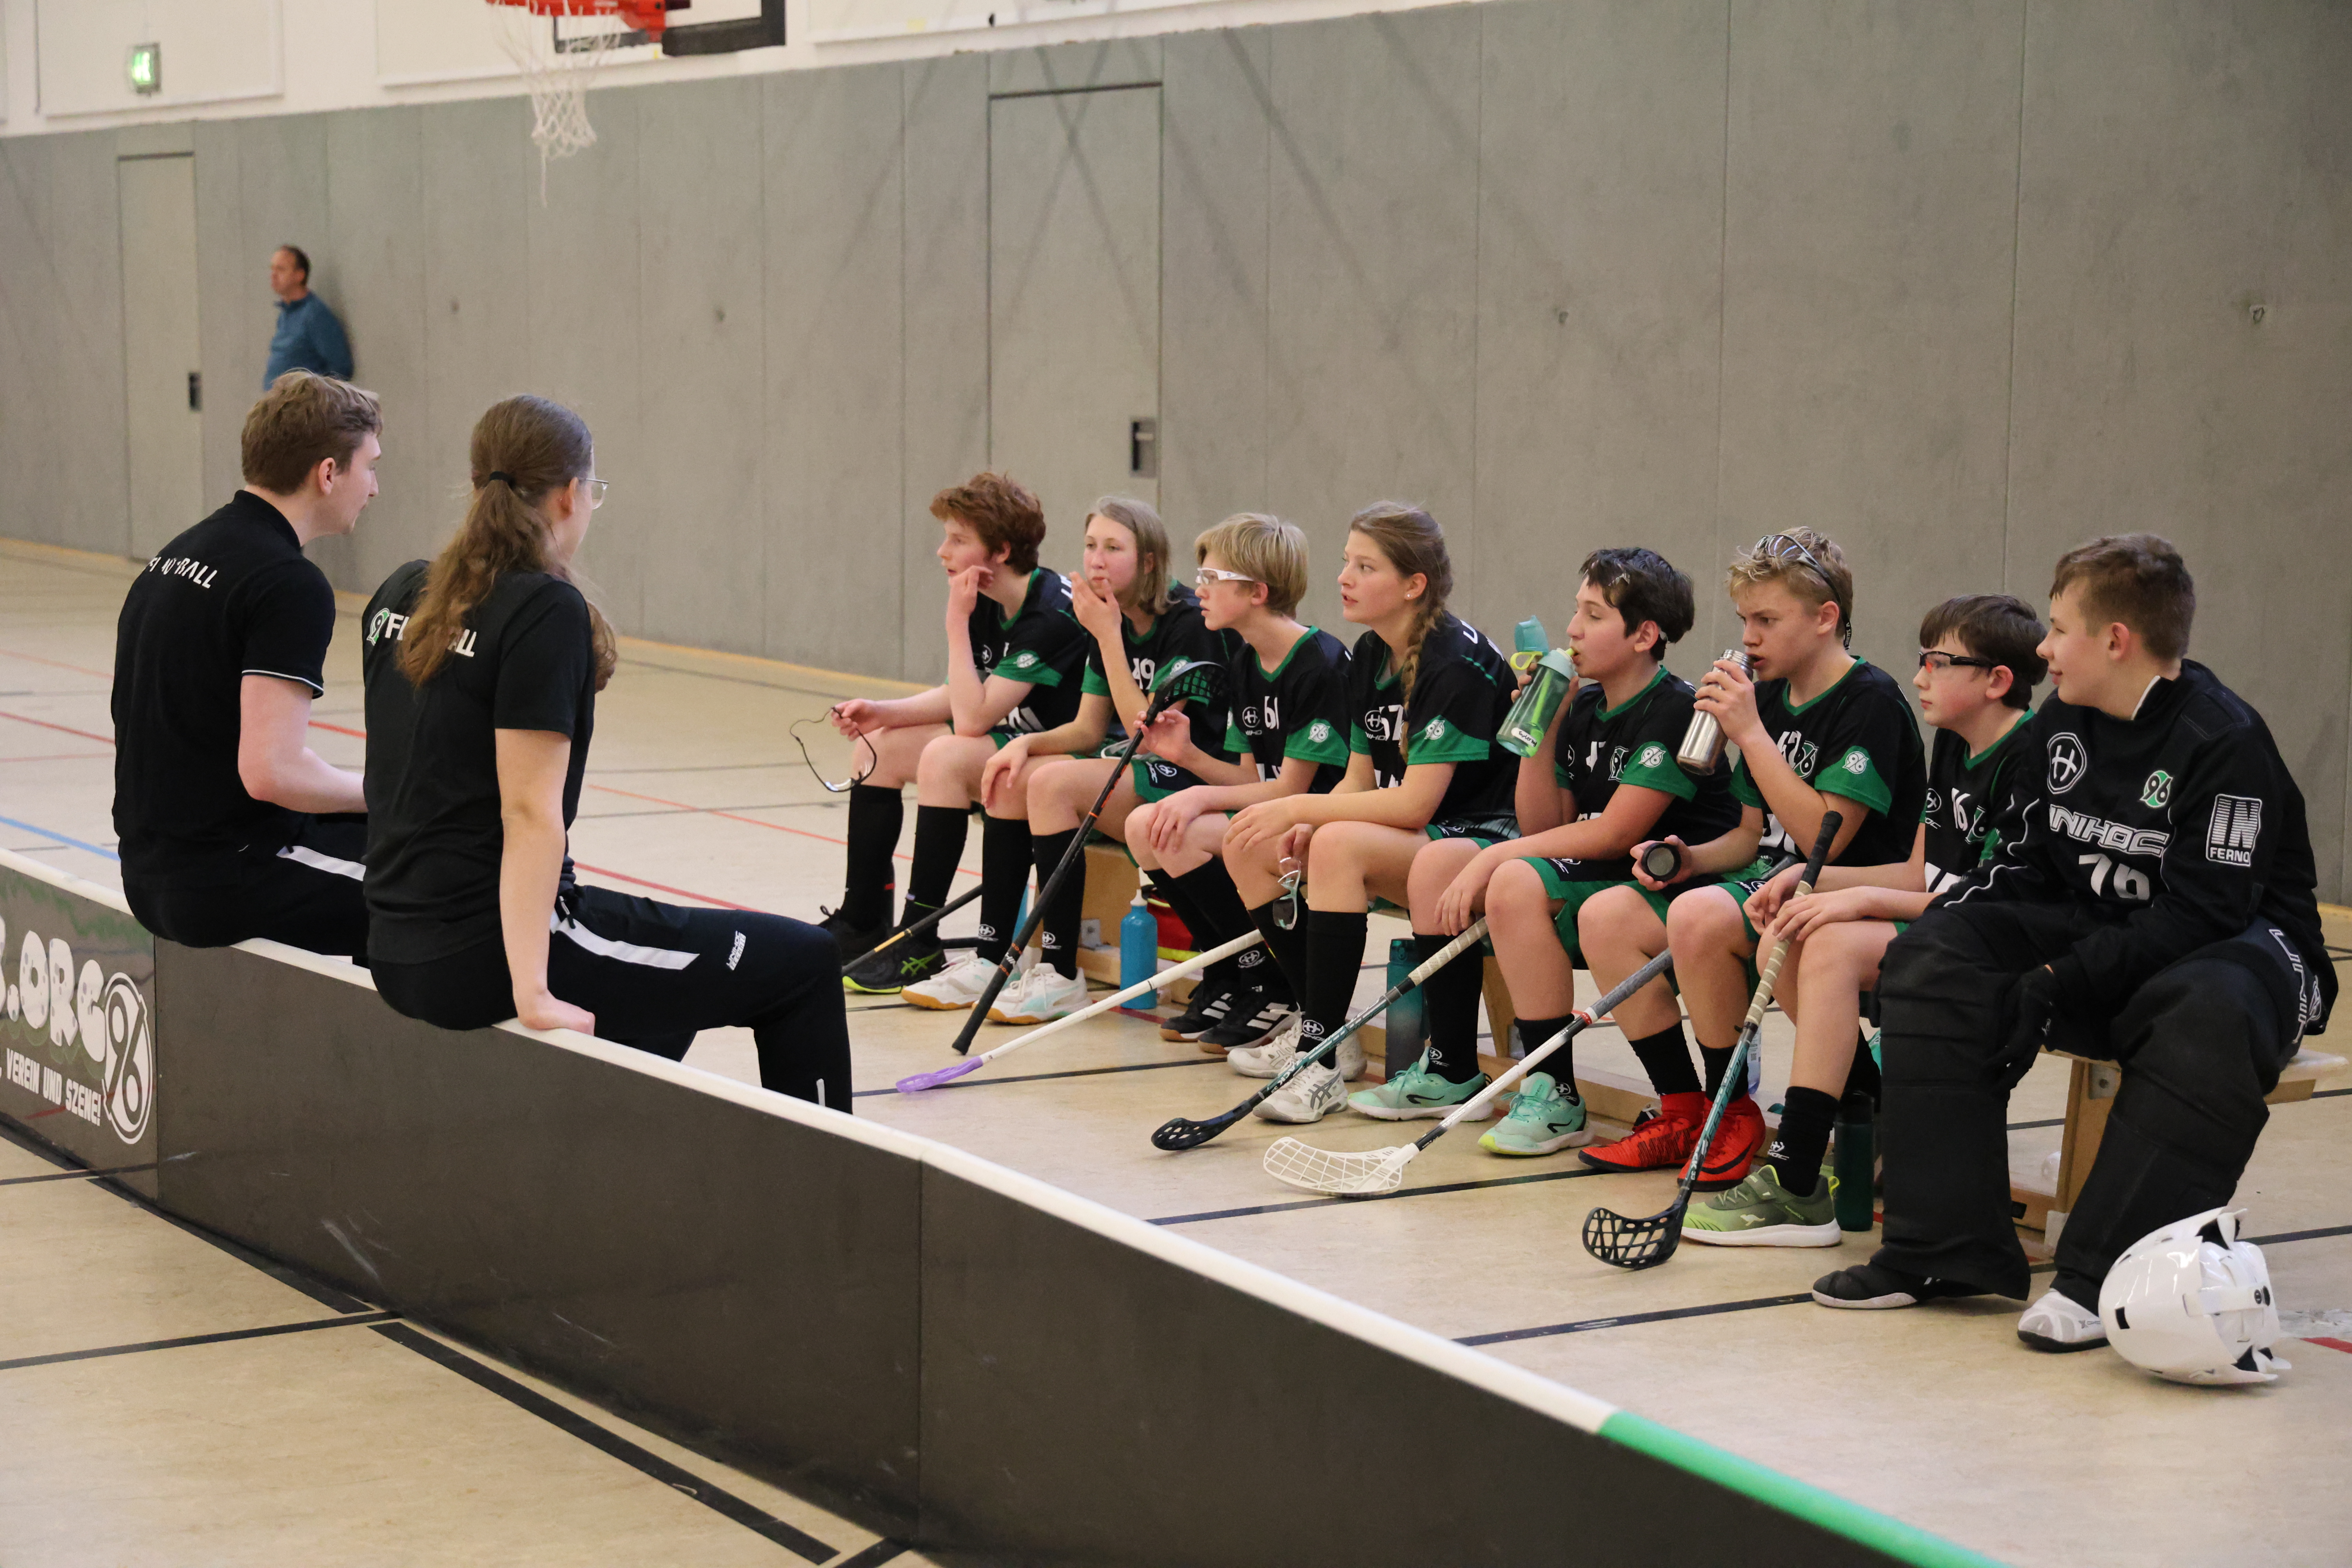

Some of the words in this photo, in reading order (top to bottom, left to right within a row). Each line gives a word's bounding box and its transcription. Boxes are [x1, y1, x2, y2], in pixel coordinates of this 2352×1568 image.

[2211, 798, 2259, 849] IN
[2210, 847, 2250, 863] FERNO
[7, 1047, 40, 1094] VEREIN
[43, 1066, 62, 1105] UND
[65, 1078, 101, 1126] SZENE!
